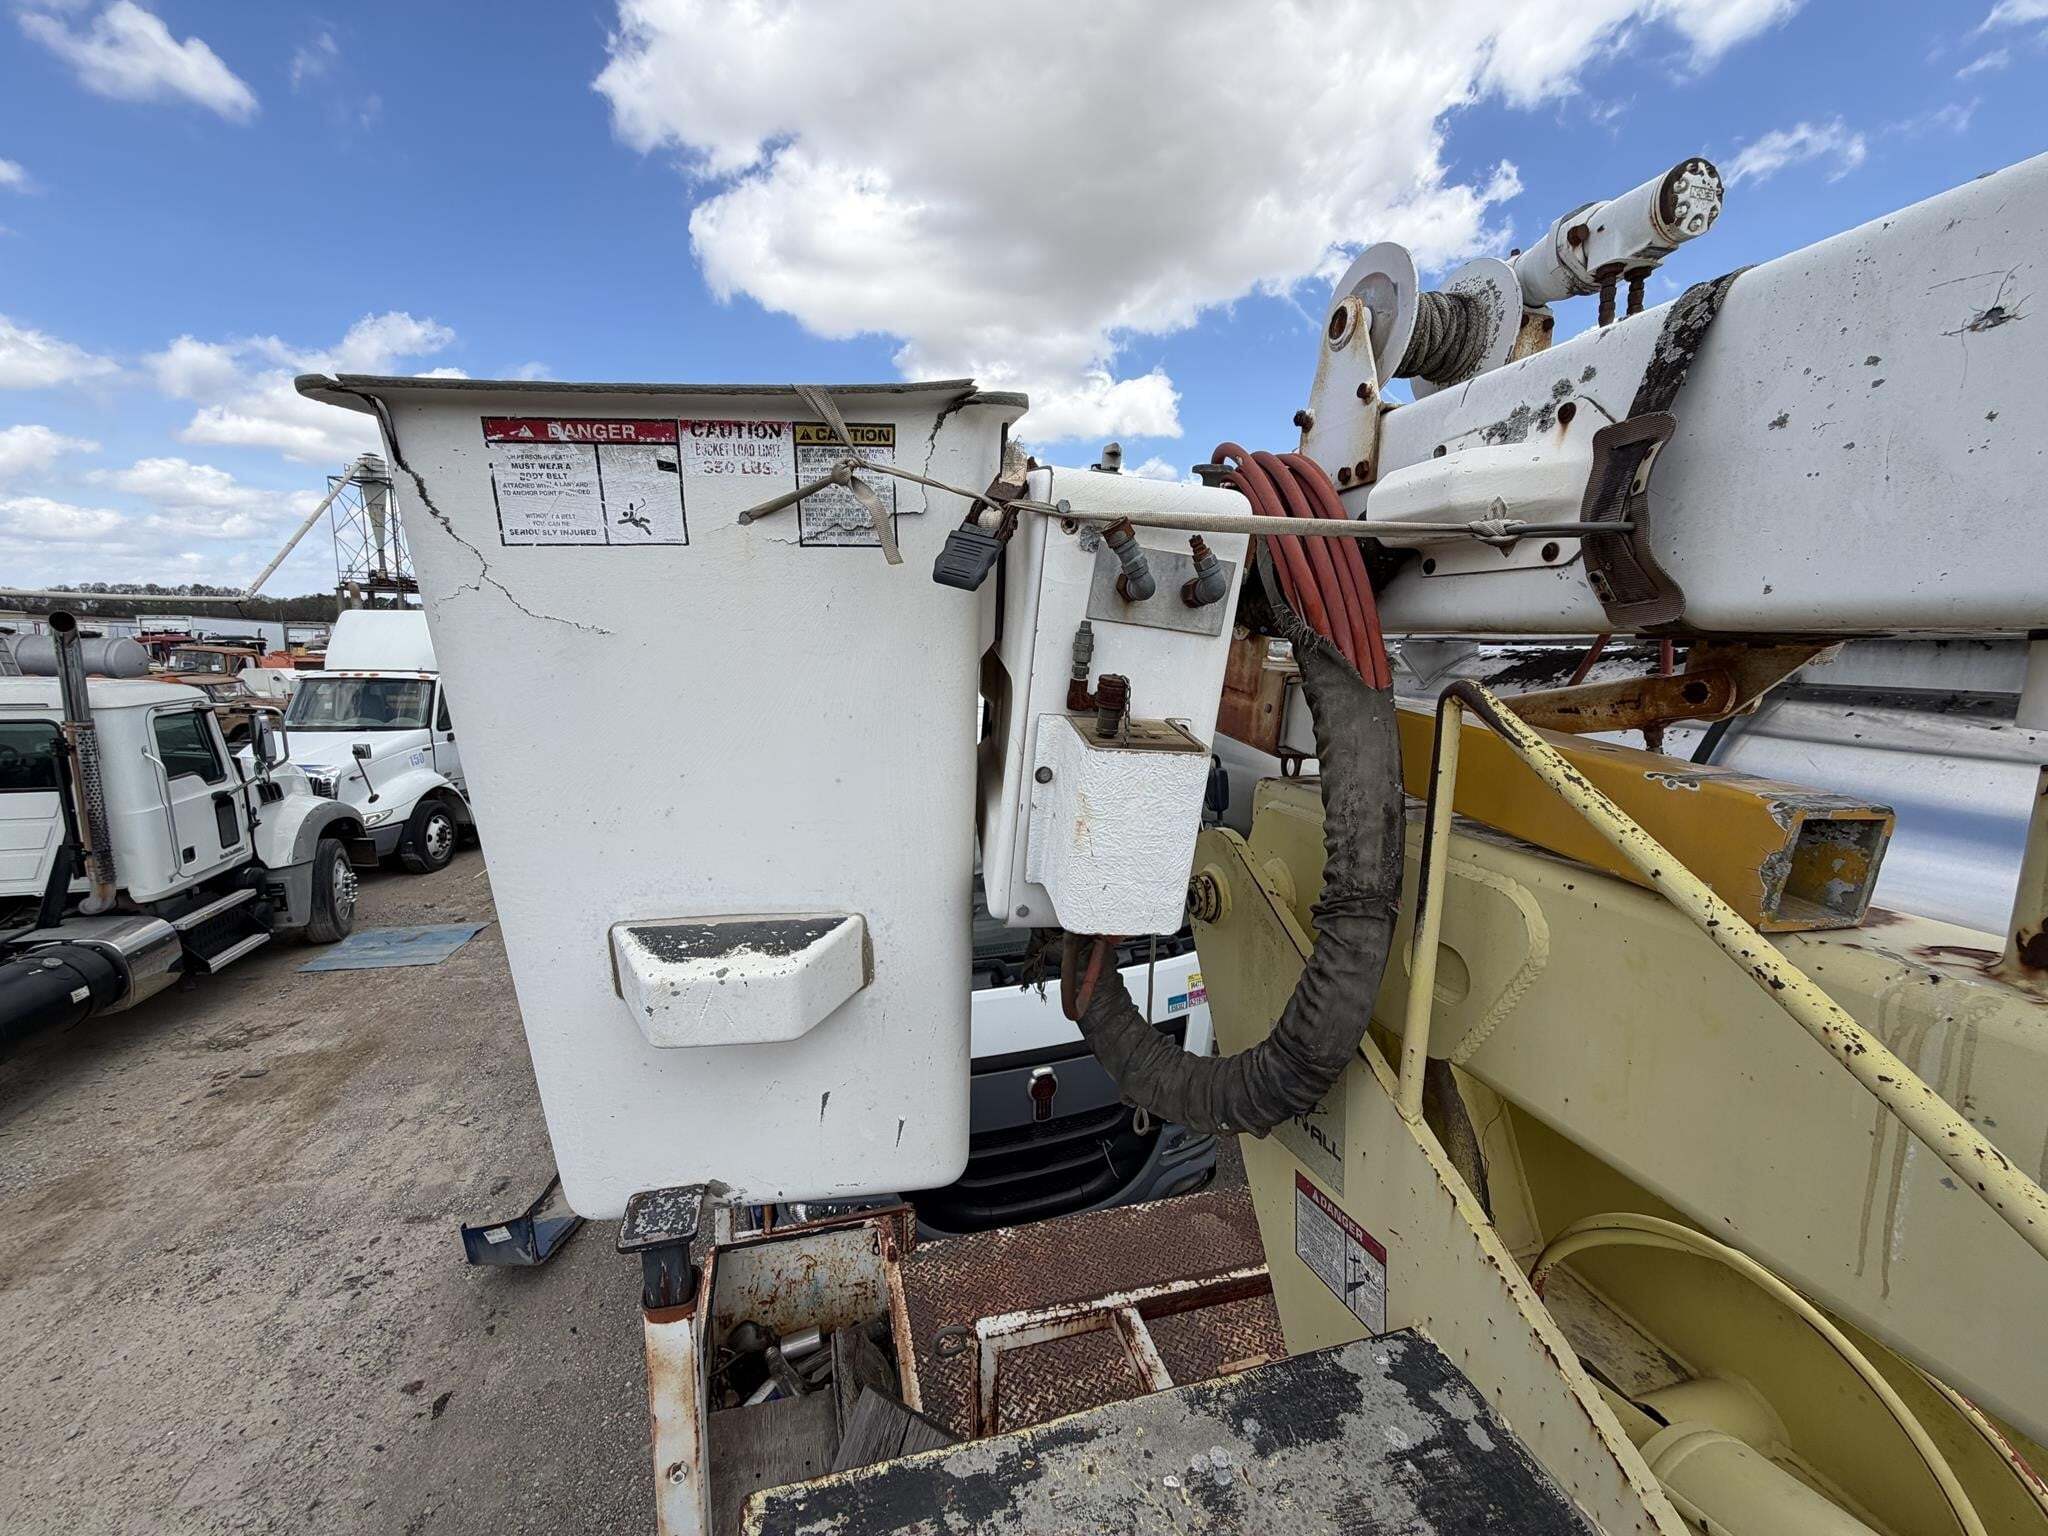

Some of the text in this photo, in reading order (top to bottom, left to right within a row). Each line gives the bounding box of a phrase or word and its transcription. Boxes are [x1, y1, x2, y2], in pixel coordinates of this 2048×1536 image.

[547, 423, 636, 440] DANGER
[690, 420, 782, 440] CAUTION
[815, 428, 891, 442] CATION
[695, 442, 781, 458] BUCKET LOAD LIMIT
[519, 473, 544, 481] BODY
[1320, 1196, 1365, 1243] DANGER
